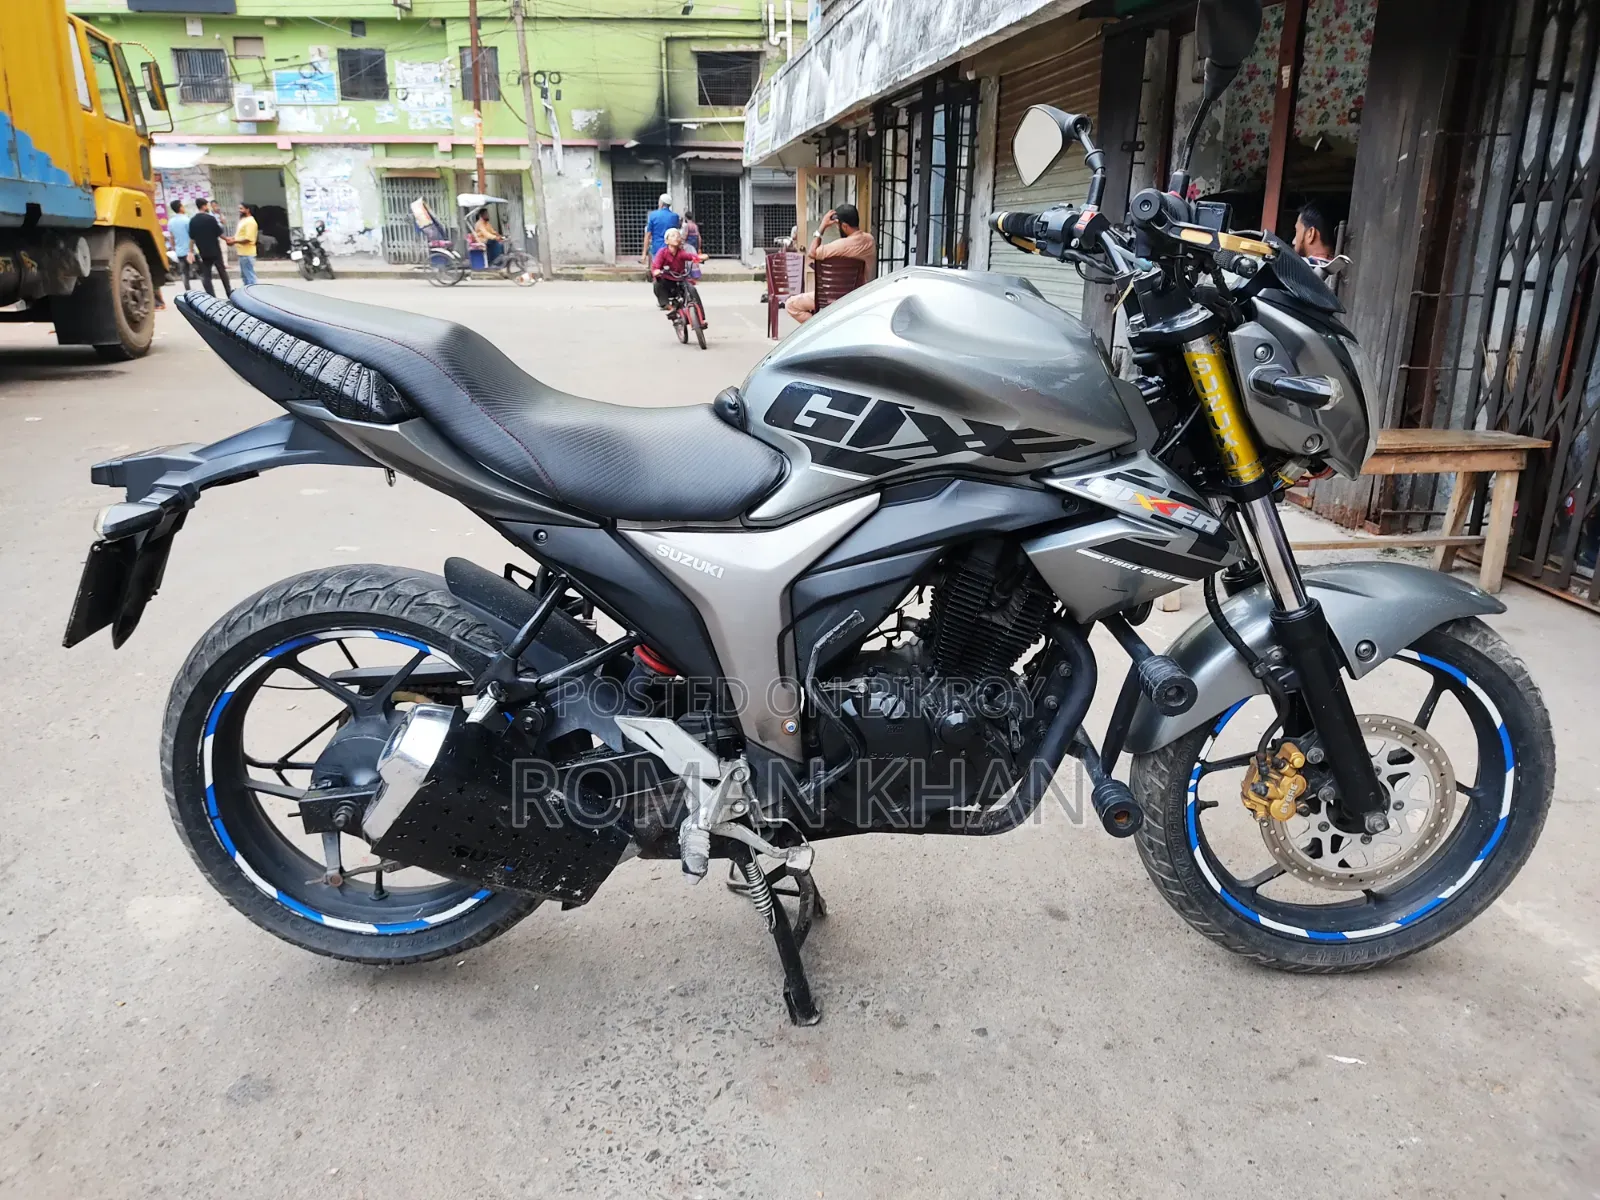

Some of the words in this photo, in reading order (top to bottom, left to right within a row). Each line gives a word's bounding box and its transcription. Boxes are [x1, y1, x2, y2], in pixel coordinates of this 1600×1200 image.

[1191, 357, 1240, 466] SUZUKI
[1086, 477, 1221, 536] GIXXER
[655, 543, 725, 579] SUZUKI
[1101, 556, 1142, 572] STREET
[1140, 568, 1175, 582] SPORT
[1280, 782, 1299, 814] BYBRE
